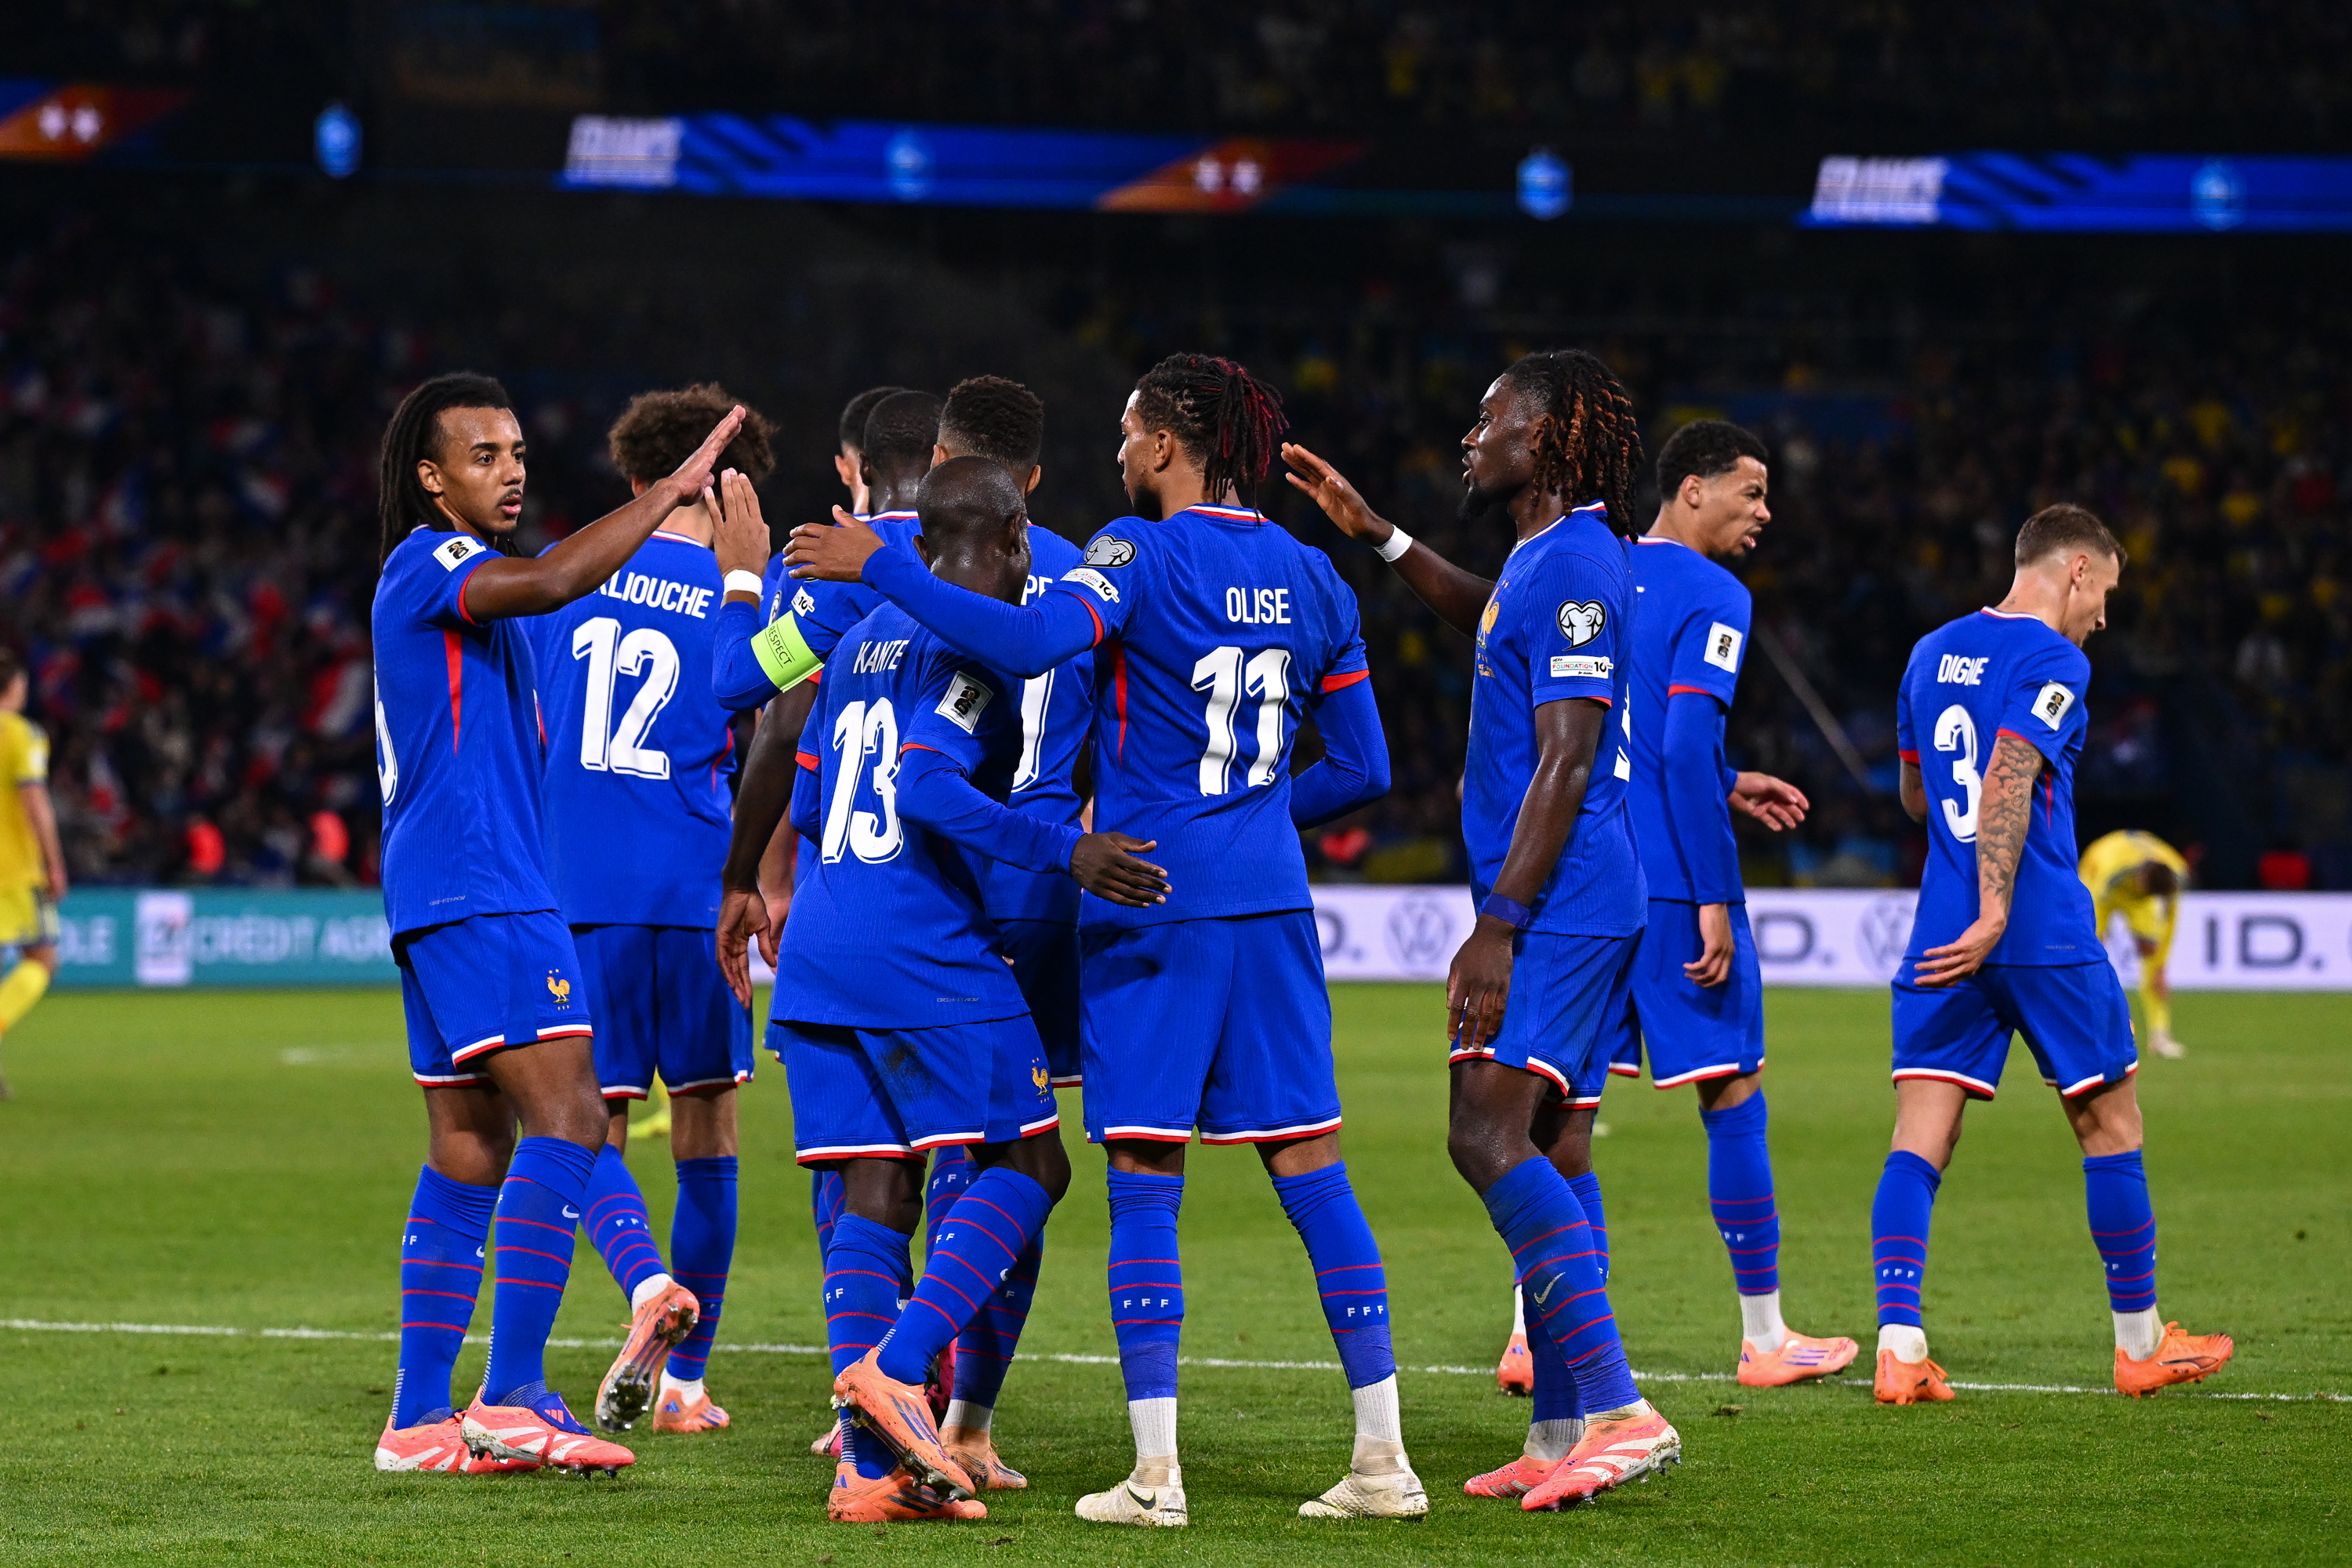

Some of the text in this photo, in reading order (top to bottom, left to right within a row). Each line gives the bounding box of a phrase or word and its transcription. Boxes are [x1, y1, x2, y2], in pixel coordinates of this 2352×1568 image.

[1225, 586, 1291, 624] OLISE
[768, 624, 793, 666] RESPECT
[852, 638, 911, 674] KANTE
[1936, 653, 1990, 687] DIGNE
[572, 616, 681, 780] 12
[1190, 645, 1291, 797] 11
[821, 696, 905, 866] 13
[1933, 704, 1981, 844] 3
[2204, 913, 2325, 971] ID.
